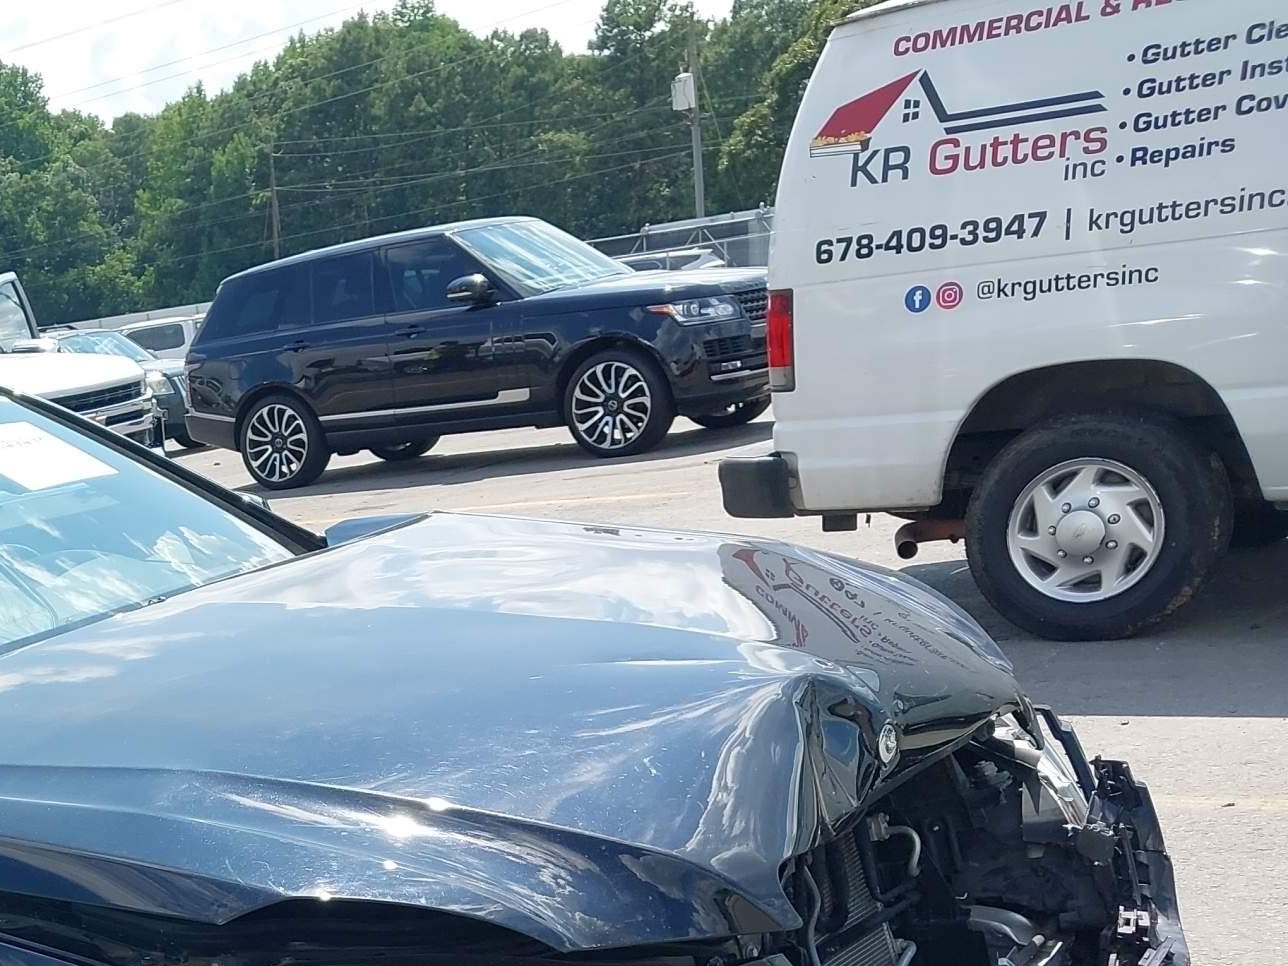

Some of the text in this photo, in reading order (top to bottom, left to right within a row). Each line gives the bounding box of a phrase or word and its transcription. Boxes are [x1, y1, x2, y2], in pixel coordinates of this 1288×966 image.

[893, 0, 1121, 57] COMMERCIAL &
[1141, 33, 1237, 64] Gutter
[1137, 68, 1232, 98] Gutter
[1133, 103, 1227, 133] Gutter
[850, 126, 1109, 188] KR Gutters
[1130, 136, 1236, 168] Repairs
[1063, 156, 1107, 181] inc
[815, 210, 1048, 265] 678-409-3947
[1088, 187, 1288, 235] krguttersinc
[977, 264, 1160, 301] @krguttersinc
